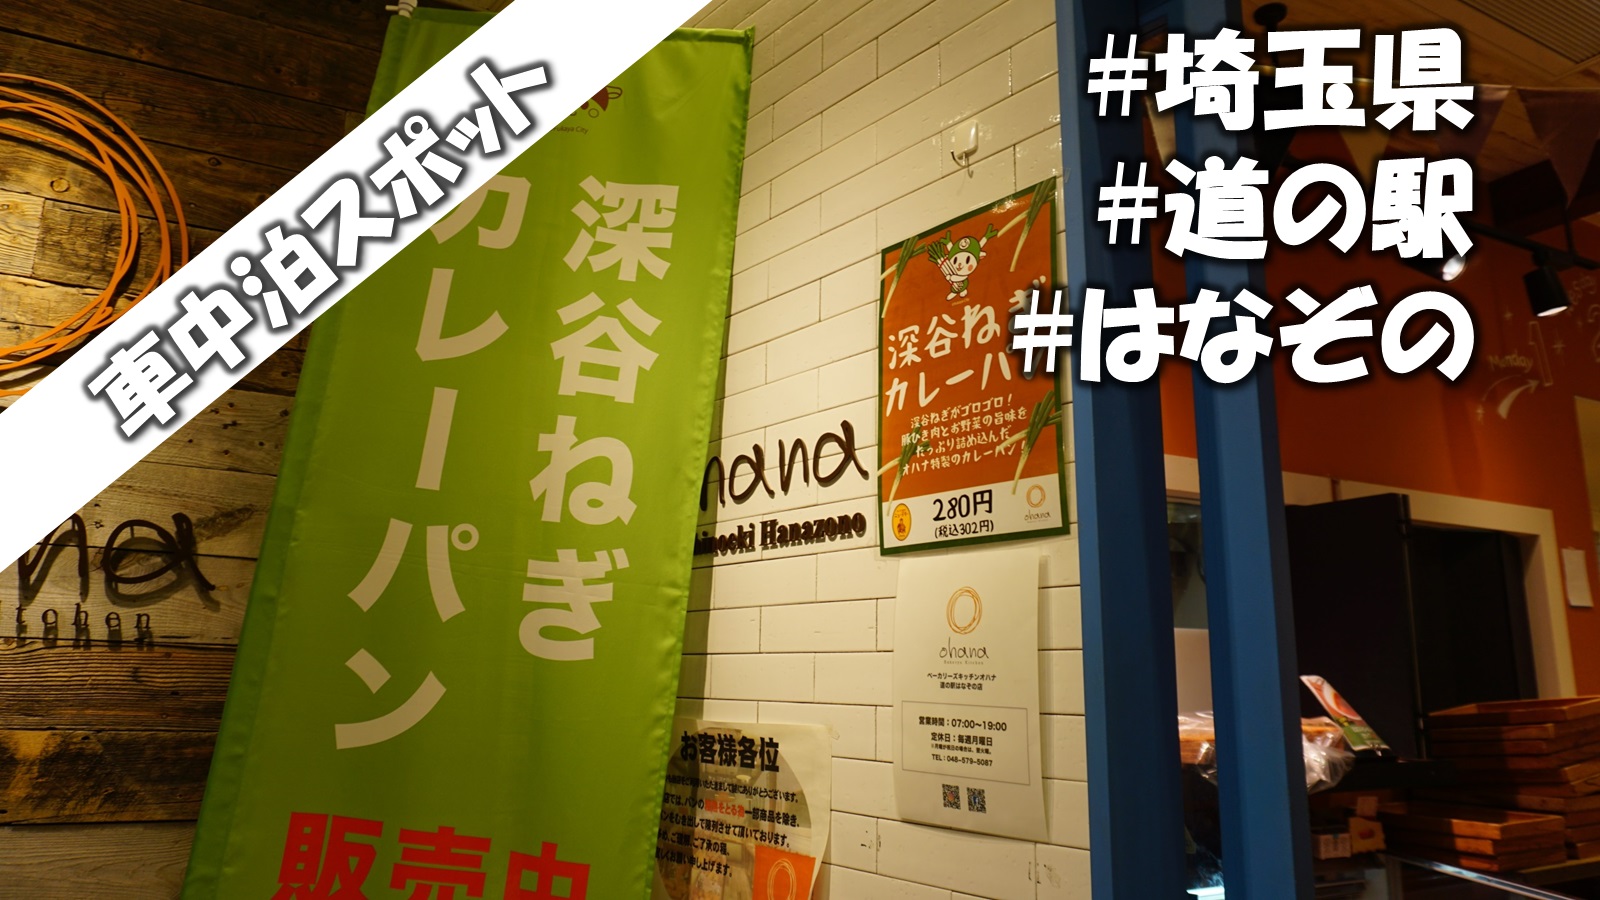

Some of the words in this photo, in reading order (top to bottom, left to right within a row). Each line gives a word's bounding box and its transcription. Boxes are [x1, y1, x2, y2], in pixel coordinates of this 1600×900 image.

[554, 125, 575, 133] ukaya
[576, 126, 589, 135] City
[518, 175, 680, 661] 深谷ねぎ
[901, 406, 1028, 447] 豚ひき肉とお野菜の旨味を
[915, 424, 1013, 458] たっぷり詰め込んだ
[932, 488, 993, 522] 280円
[759, 511, 867, 547] Hanazono
[939, 636, 990, 660] ohana
[680, 730, 780, 773] お客様各位
[271, 811, 591, 900] 販売中
